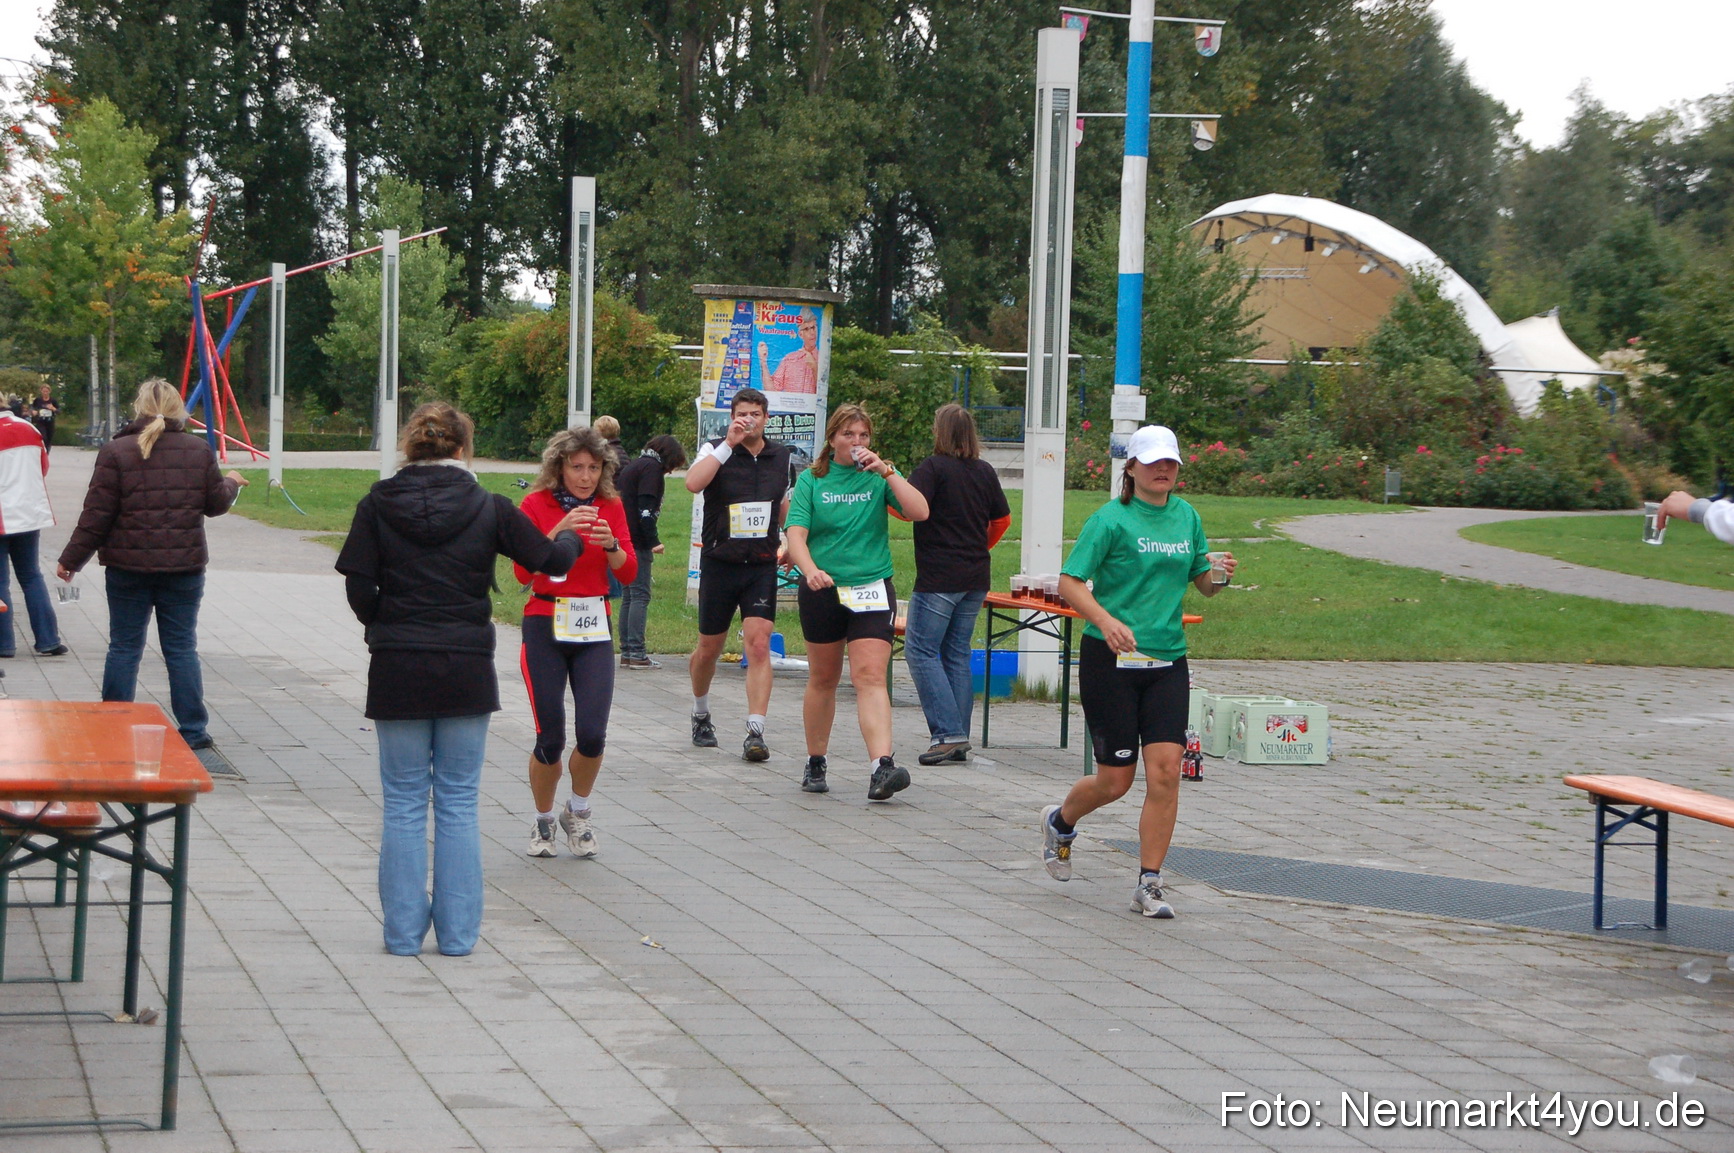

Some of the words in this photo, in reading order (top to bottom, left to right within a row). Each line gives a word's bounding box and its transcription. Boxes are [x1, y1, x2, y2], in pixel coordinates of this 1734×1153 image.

[761, 311, 804, 324] Kraus
[765, 415, 783, 427] ock
[784, 415, 793, 426] &
[821, 491, 872, 505] Sinupret
[746, 516, 765, 527] 187
[1137, 537, 1191, 557] Sinupret
[856, 590, 879, 600] 220
[570, 602, 589, 611] Heike
[575, 615, 598, 629] 464
[1260, 742, 1314, 755] NEUMARKTER
